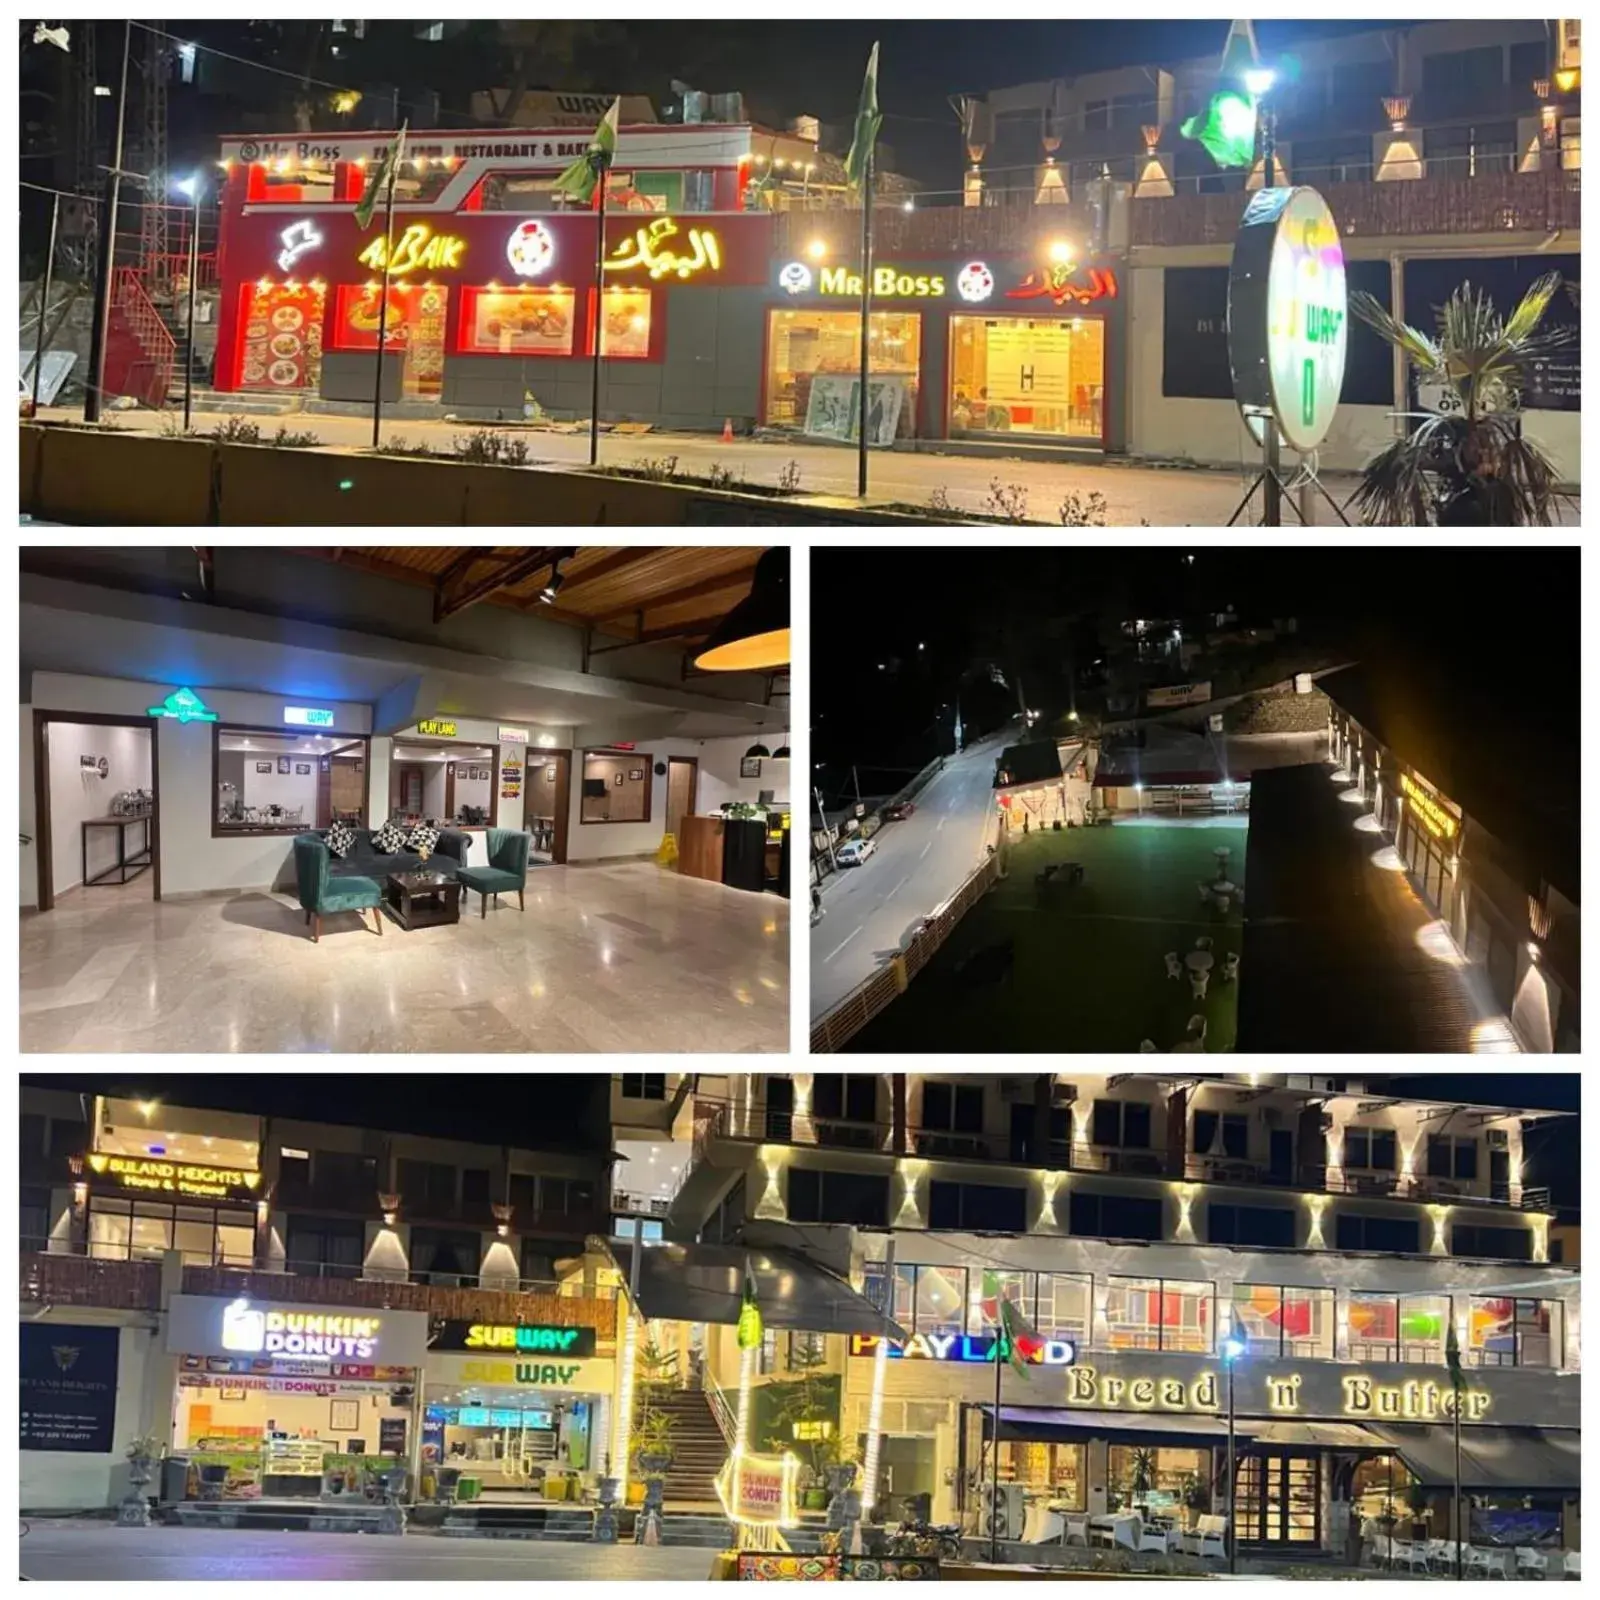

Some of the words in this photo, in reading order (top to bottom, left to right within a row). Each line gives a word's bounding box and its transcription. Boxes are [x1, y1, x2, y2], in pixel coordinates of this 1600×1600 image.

[543, 143, 552, 157] &
[109, 1158, 174, 1178] BULAND
[177, 1166, 243, 1186] HEIGHTS
[464, 1324, 578, 1349] SUBWAY
[459, 1361, 581, 1384] SUBWAY
[1067, 1364, 1218, 1411] Bread
[1342, 1374, 1492, 1420] Butter
